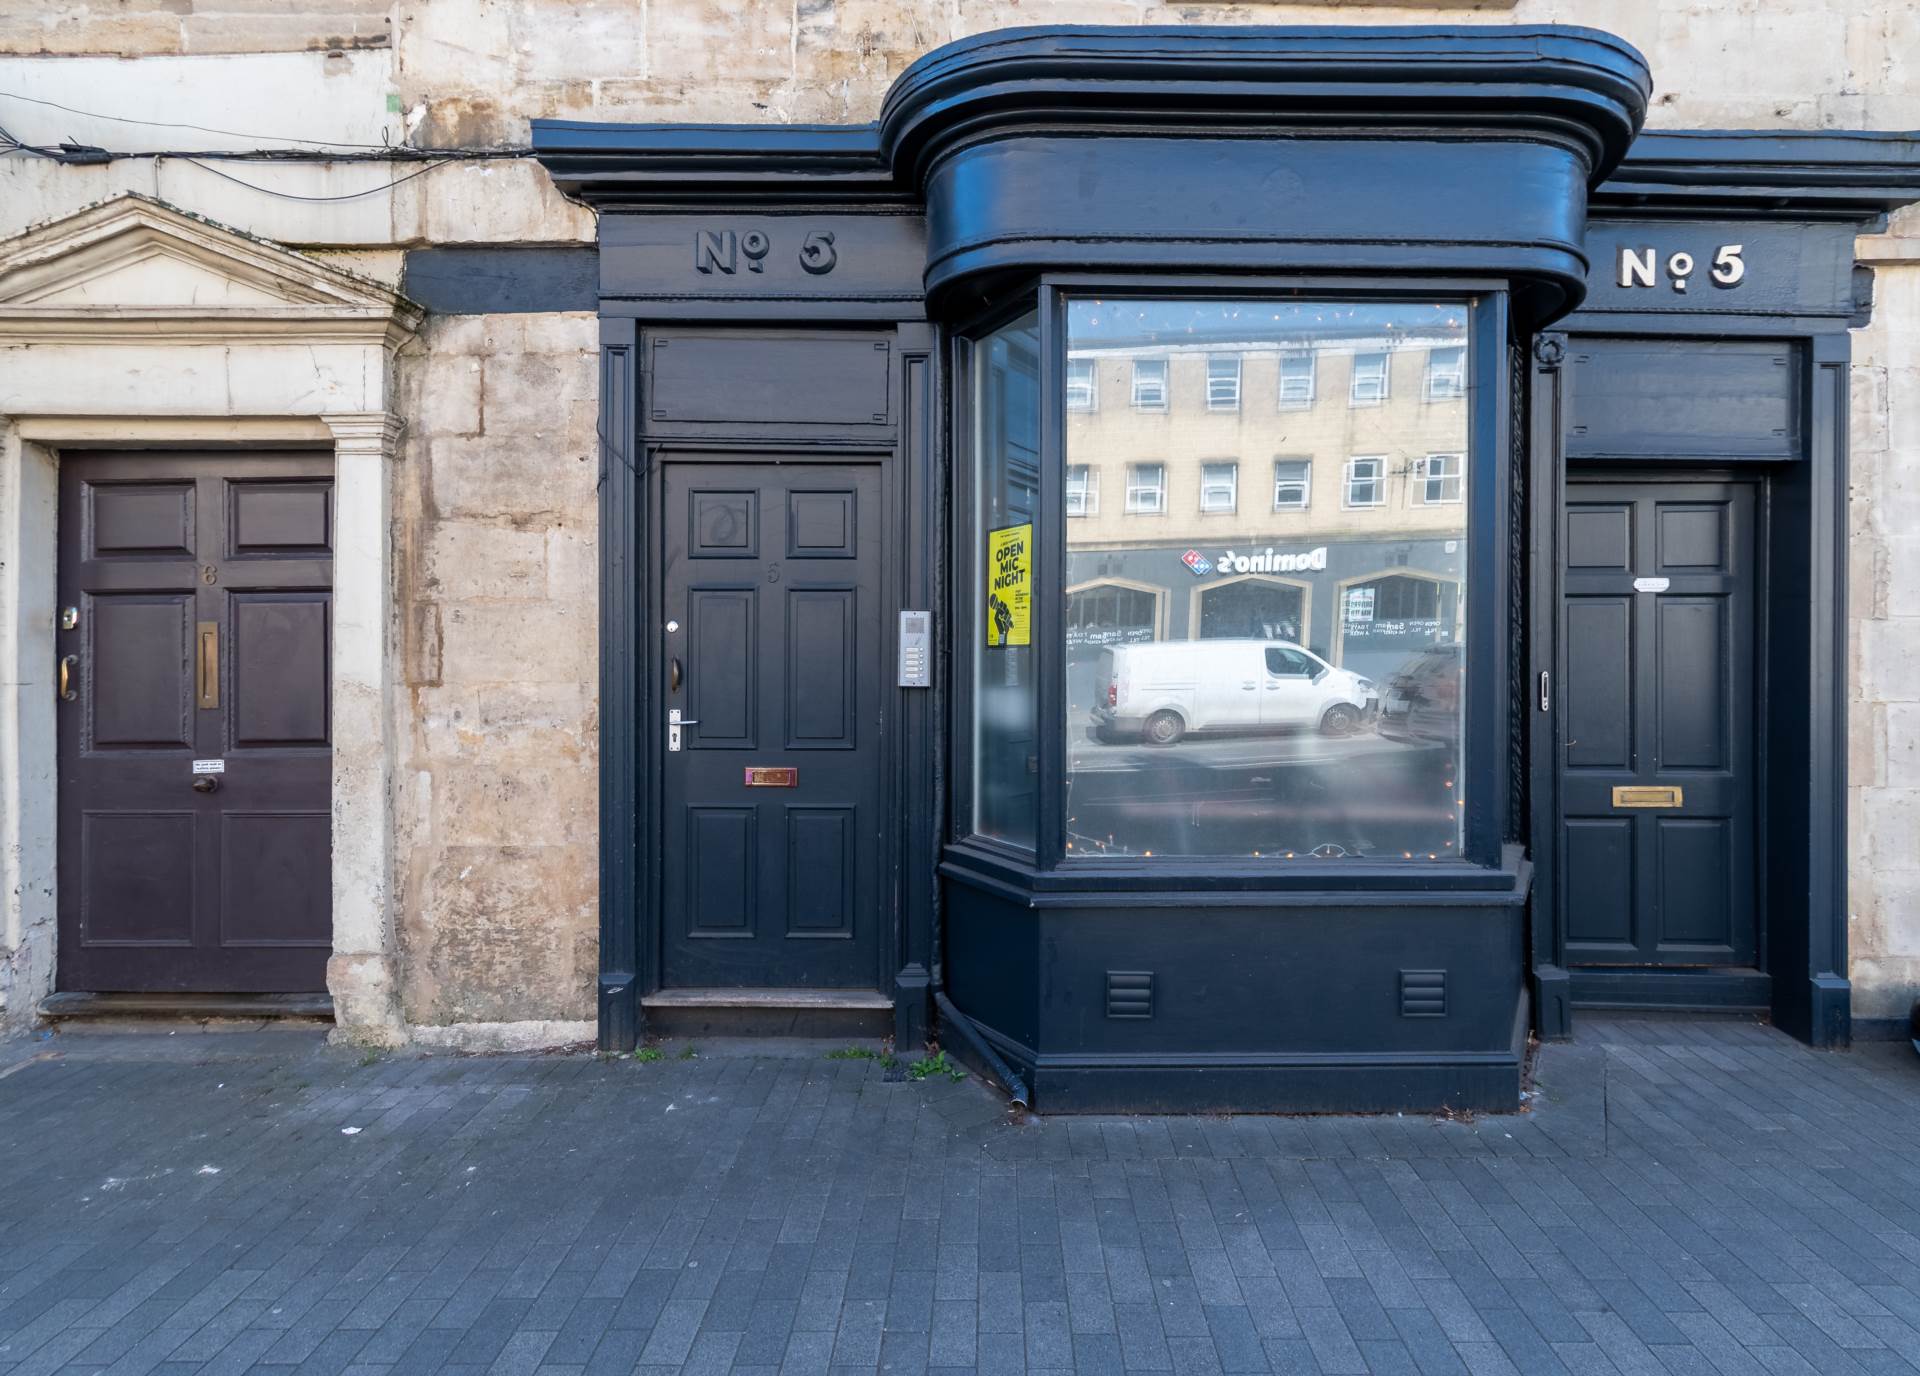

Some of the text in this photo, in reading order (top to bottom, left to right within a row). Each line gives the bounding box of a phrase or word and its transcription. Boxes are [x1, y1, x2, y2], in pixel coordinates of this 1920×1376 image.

[799, 230, 837, 275] 5
[1710, 244, 1745, 286] 5
[996, 541, 1025, 562] OPEN
[1000, 557, 1019, 575] MIC
[994, 568, 1026, 590] NIGHT
